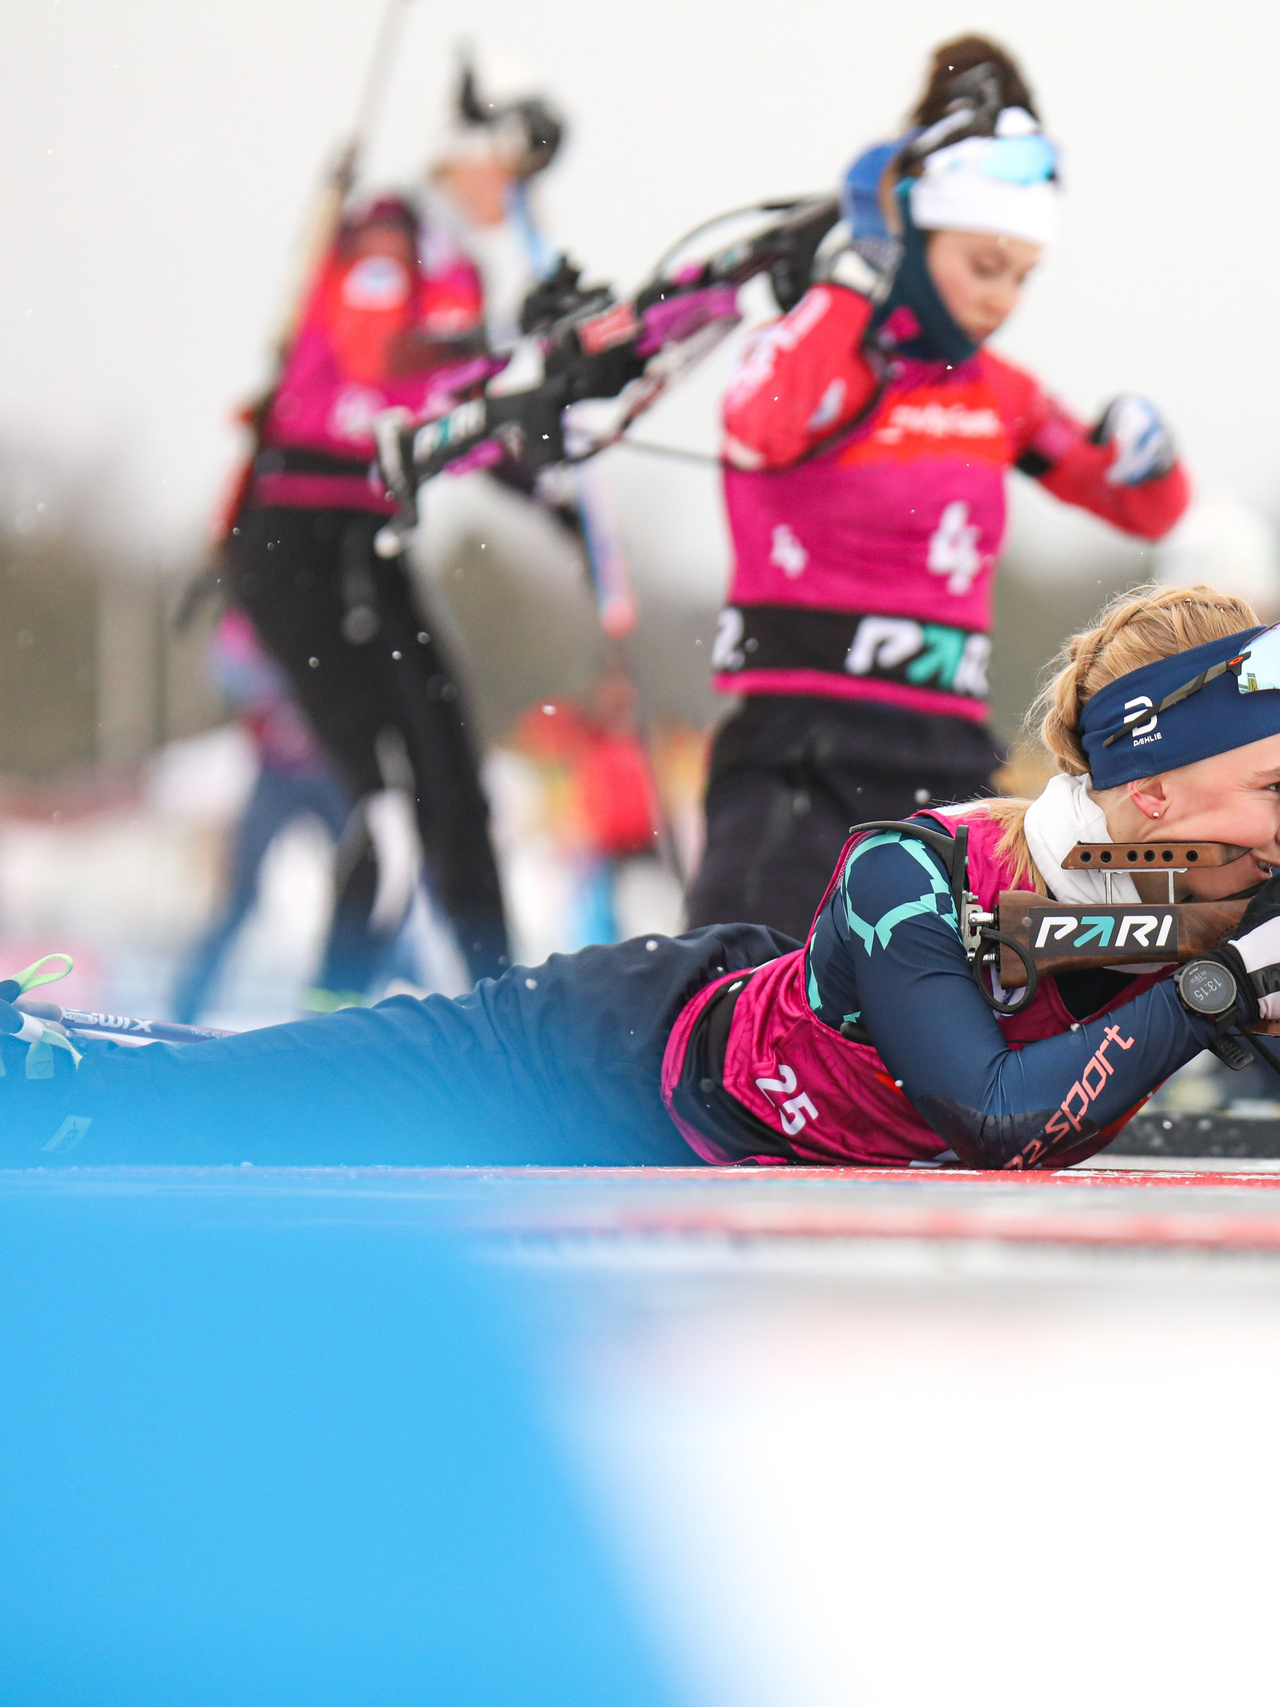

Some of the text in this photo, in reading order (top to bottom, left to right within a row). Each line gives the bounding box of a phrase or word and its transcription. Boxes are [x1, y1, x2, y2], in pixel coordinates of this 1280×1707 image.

[771, 524, 808, 579] 4
[928, 501, 981, 595] 4
[845, 615, 991, 697] PAR
[1034, 914, 1173, 948] PARI
[1193, 977, 1223, 1001] 13:15
[755, 1064, 819, 1135] 25
